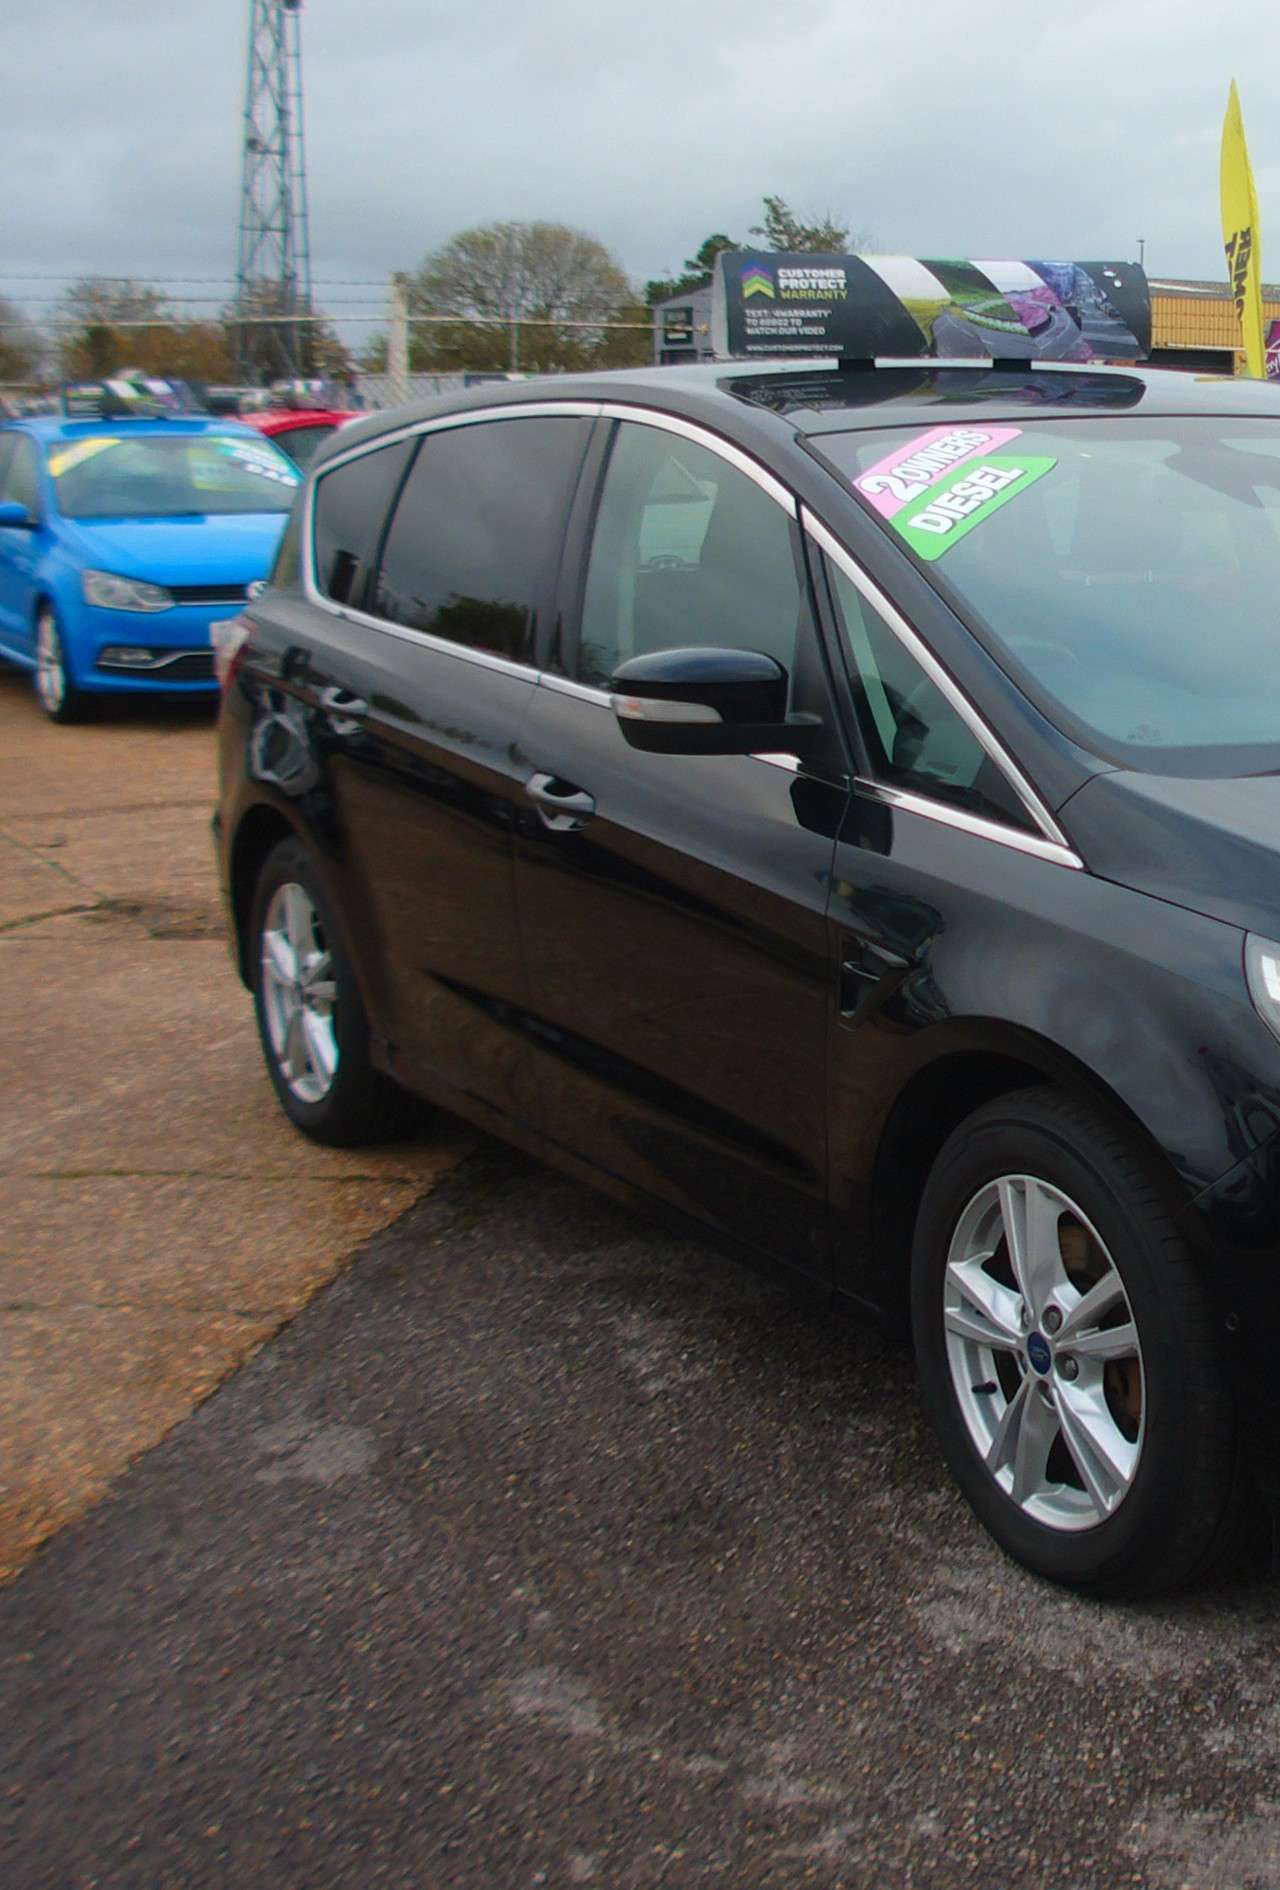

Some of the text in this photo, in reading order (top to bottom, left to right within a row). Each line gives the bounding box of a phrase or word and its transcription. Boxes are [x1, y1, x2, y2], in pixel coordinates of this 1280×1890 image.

[778, 268, 846, 278] CUSTOMER
[779, 279, 848, 289] PROTECT
[780, 290, 849, 300] WARRANTY
[906, 465, 1027, 535] DIESEL
